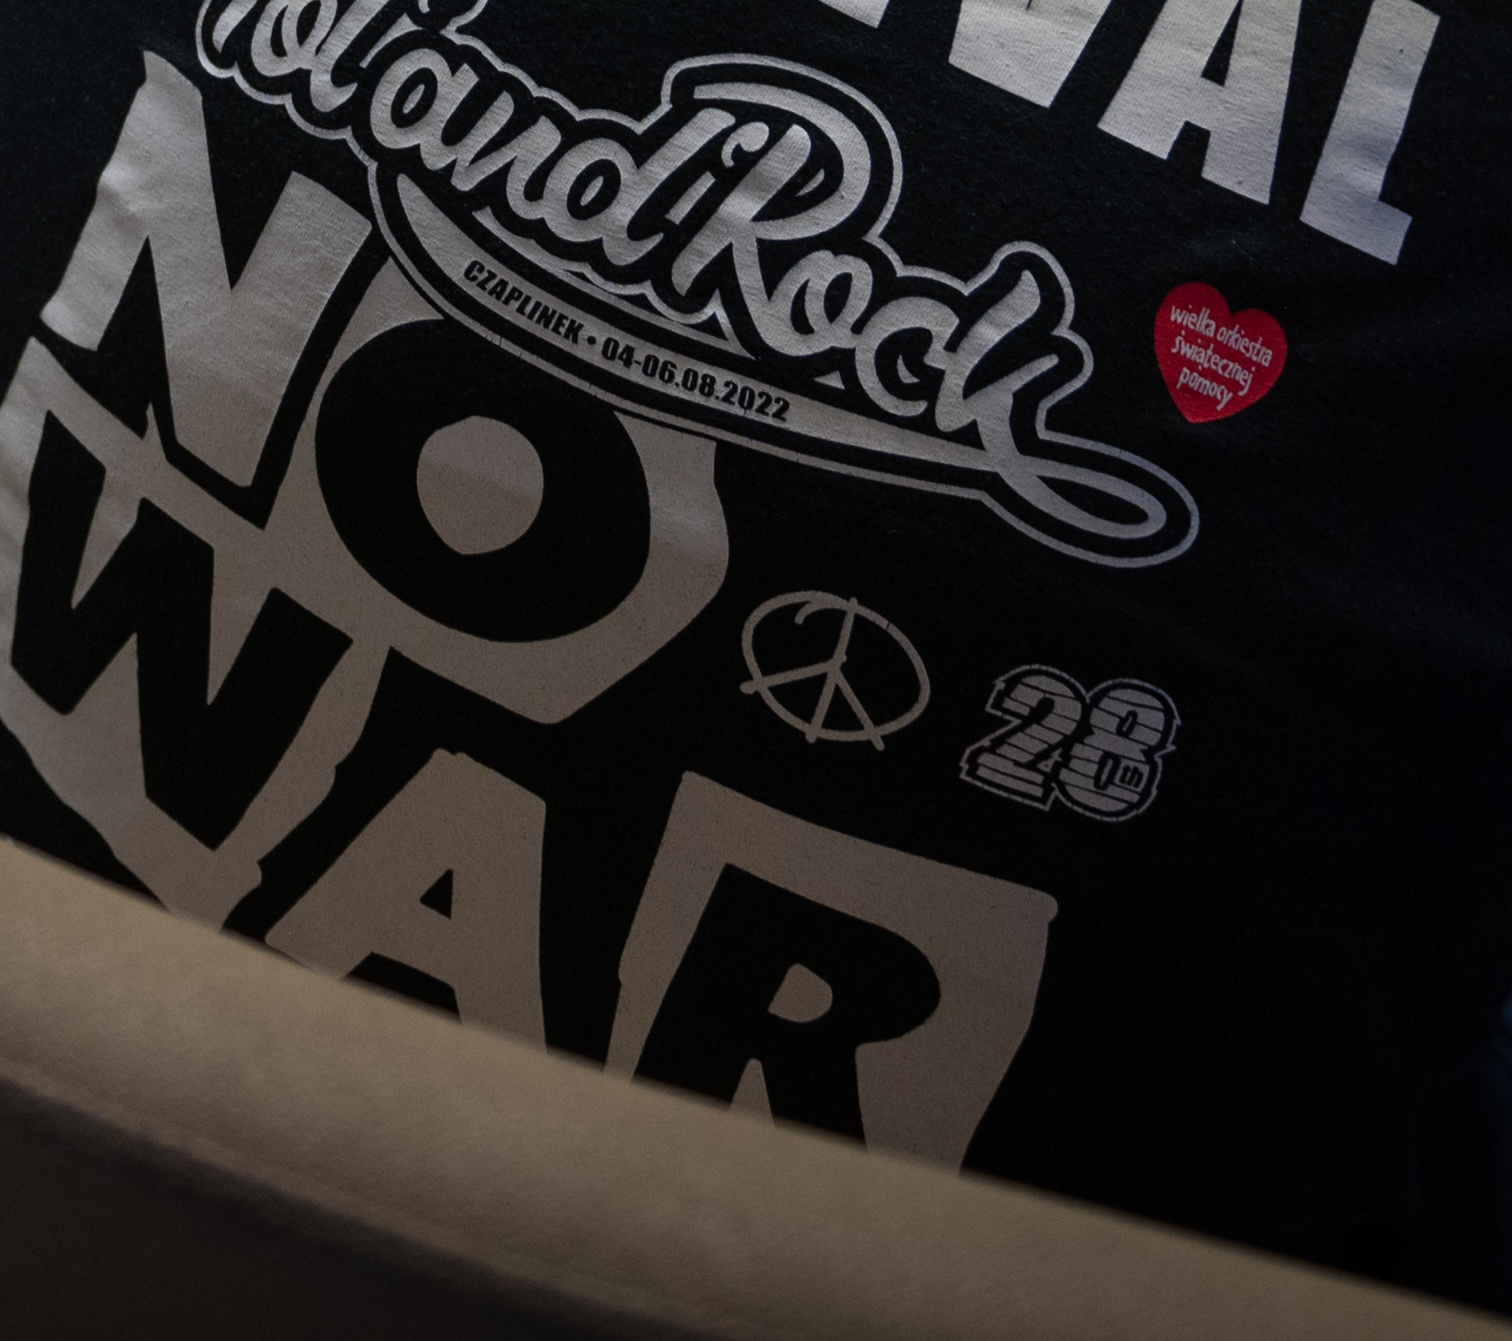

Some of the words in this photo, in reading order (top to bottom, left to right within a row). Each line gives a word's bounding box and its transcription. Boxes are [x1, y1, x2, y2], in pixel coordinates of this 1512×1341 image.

[41, 50, 652, 642] NO
[463, 260, 585, 344] CZAPLINEK
[600, 336, 791, 422] 04-06.08.2022
[1170, 304, 1217, 338] wielka
[1217, 324, 1274, 367] orkiestra
[1171, 330, 1257, 396] świątecznej
[1177, 367, 1234, 411] pomocy
[10, 412, 942, 1162] WAR
